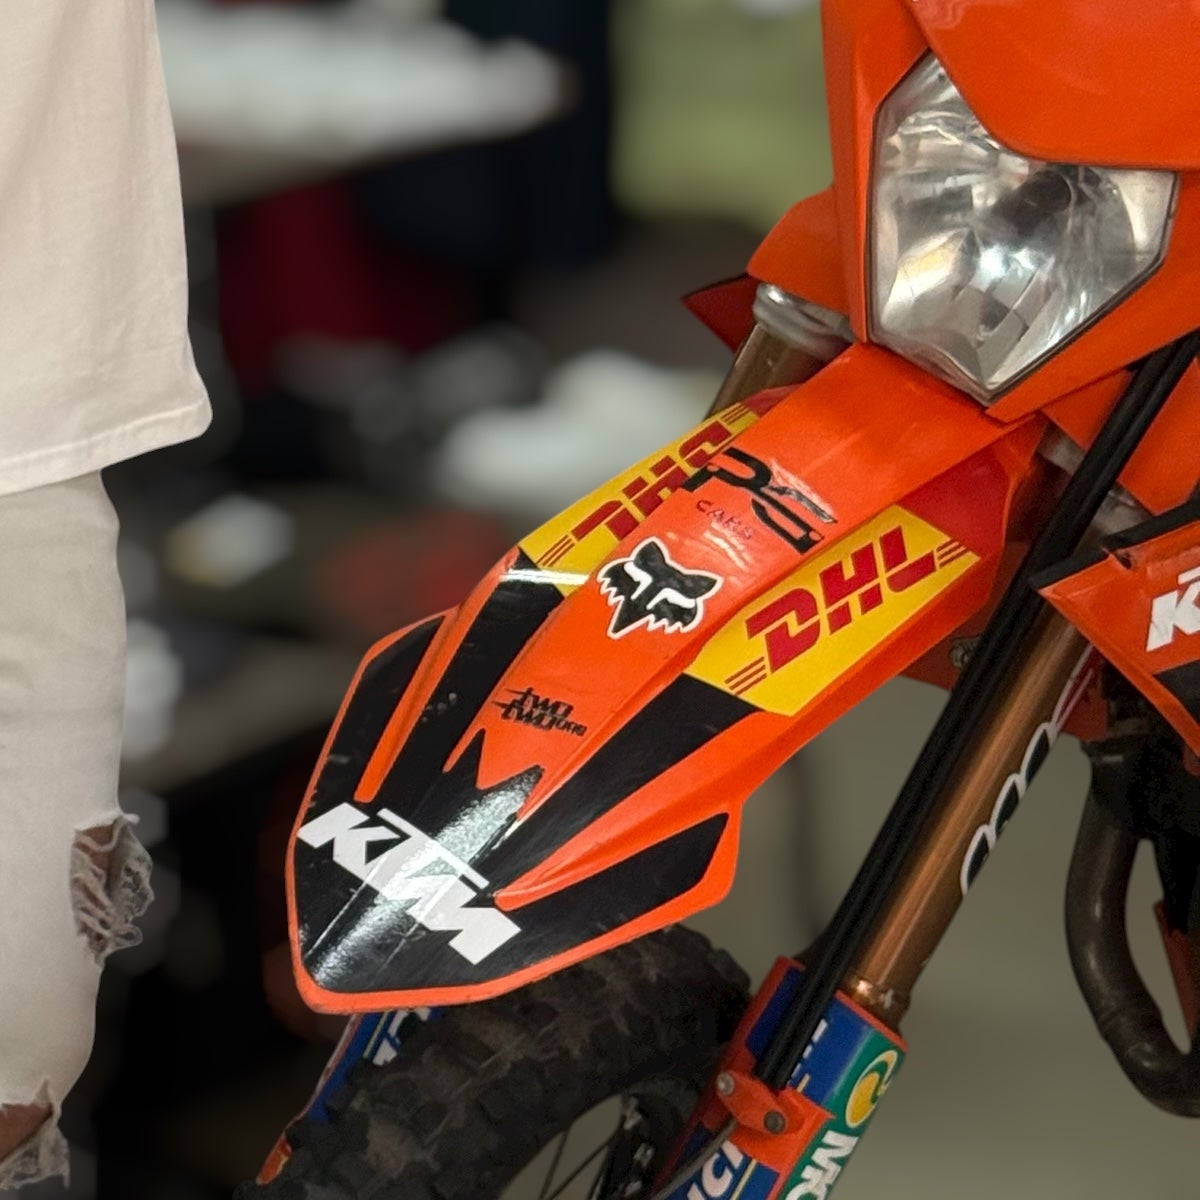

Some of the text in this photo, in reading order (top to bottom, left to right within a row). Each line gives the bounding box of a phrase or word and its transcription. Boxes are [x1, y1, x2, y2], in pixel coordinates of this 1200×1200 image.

[571, 420, 732, 540] DHL
[745, 525, 937, 674] DHL
[297, 802, 521, 966] KTM
